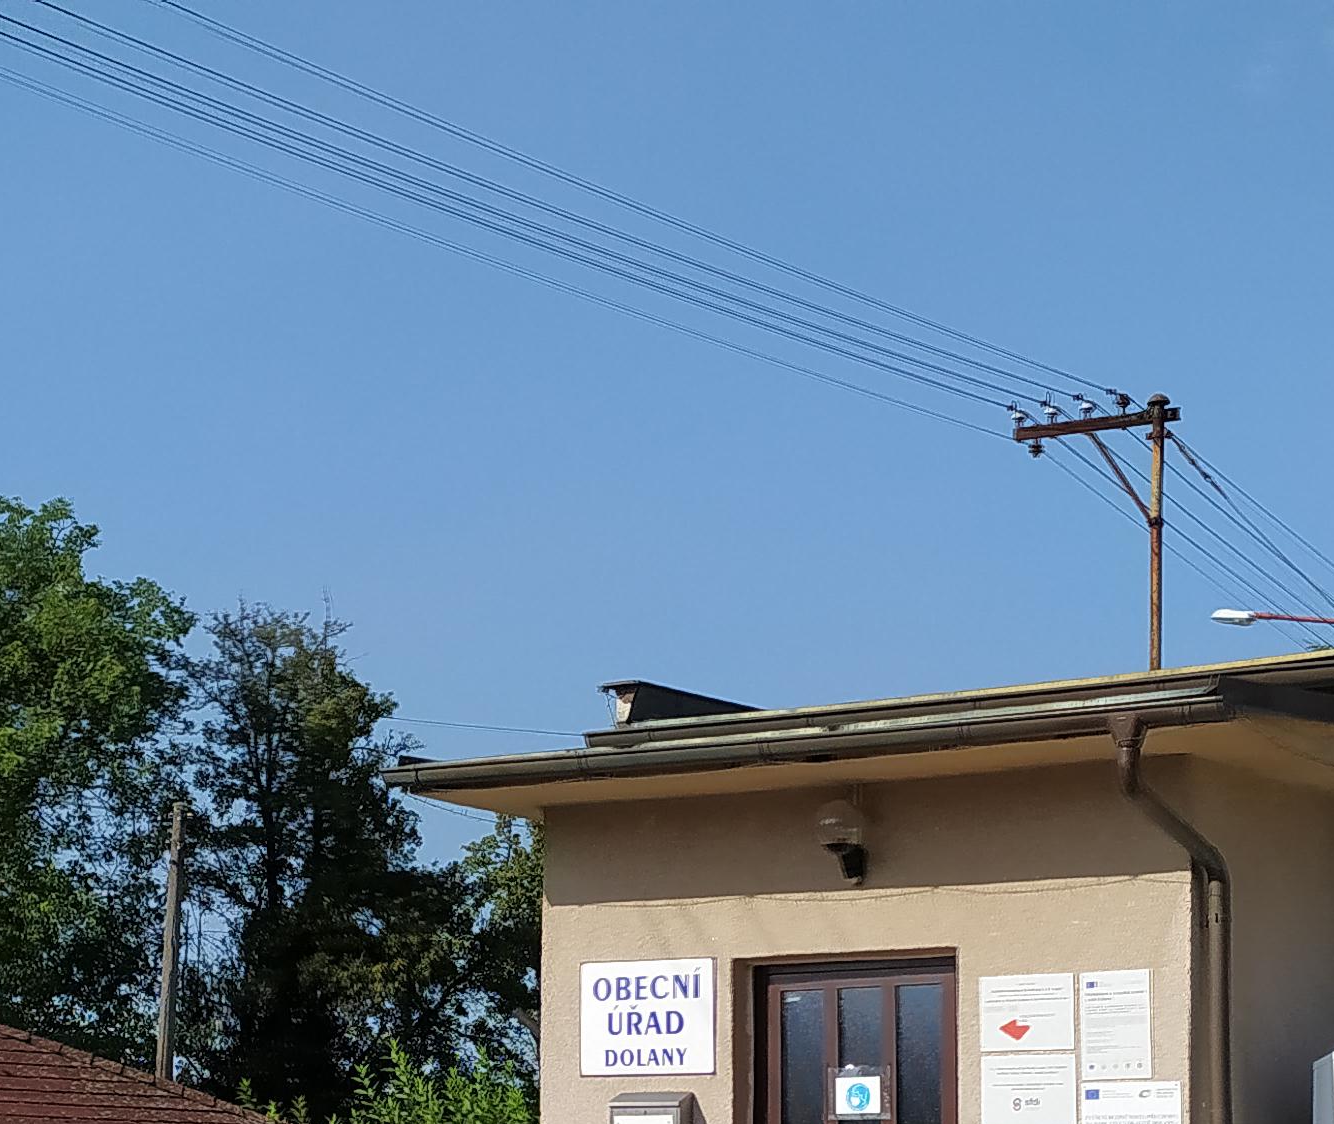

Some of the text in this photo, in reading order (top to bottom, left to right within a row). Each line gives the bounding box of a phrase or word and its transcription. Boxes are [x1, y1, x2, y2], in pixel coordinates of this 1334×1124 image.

[592, 967, 702, 1002] OBECNÍ
[607, 1005, 685, 1036] ÚŘAD
[605, 1048, 688, 1067] DOLANY
